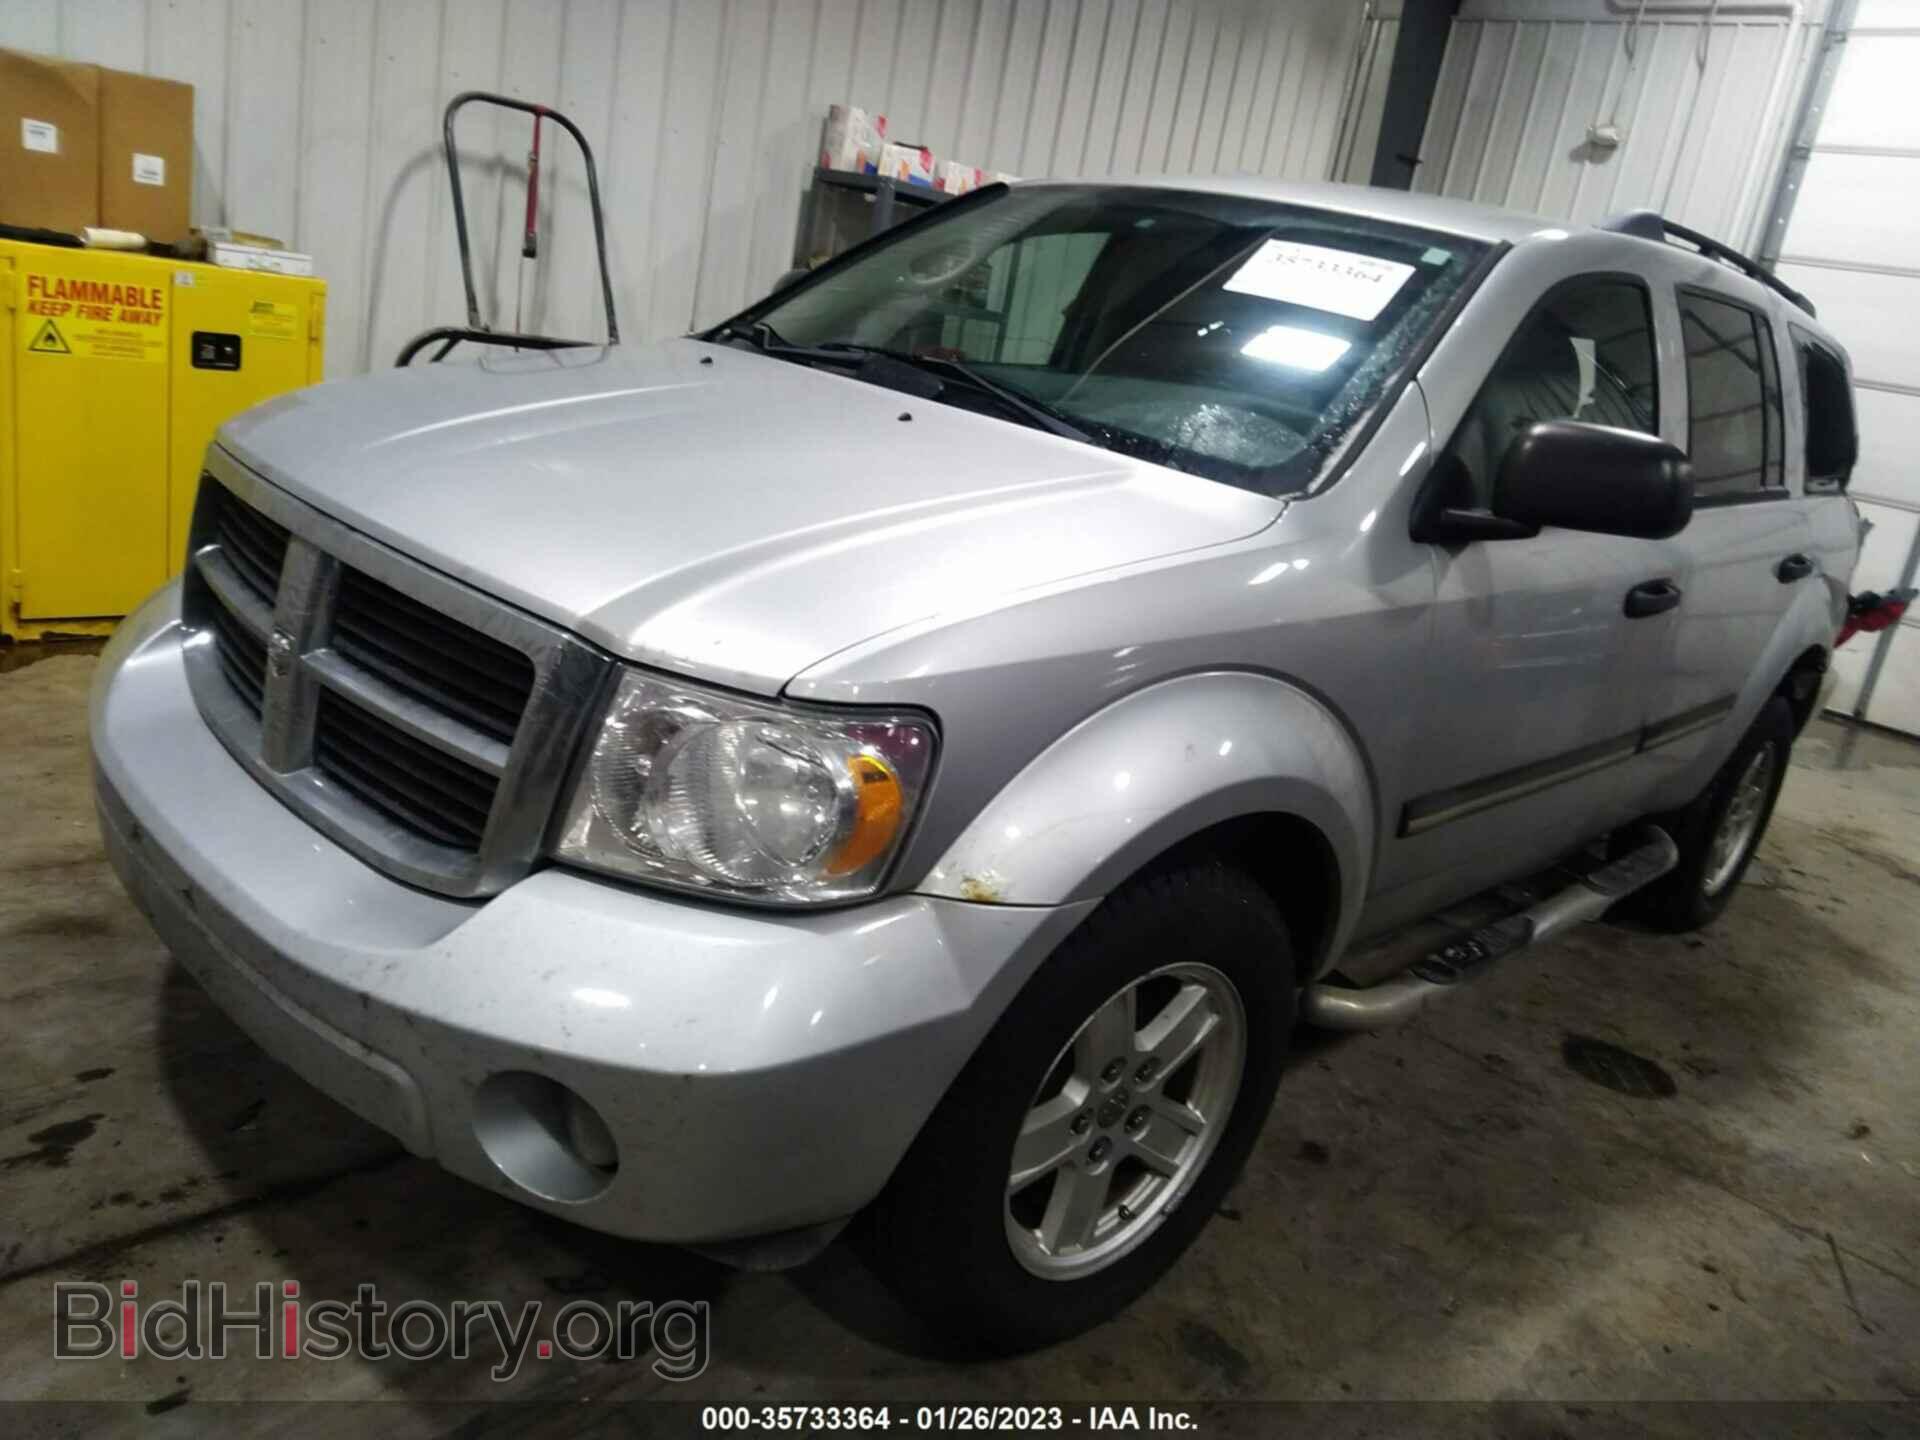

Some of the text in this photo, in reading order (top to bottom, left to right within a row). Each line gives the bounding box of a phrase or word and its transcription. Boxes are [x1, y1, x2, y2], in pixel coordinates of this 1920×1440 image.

[27, 274, 163, 310] FLAMMABLE
[27, 300, 163, 327] KEEP FIRE AWAY
